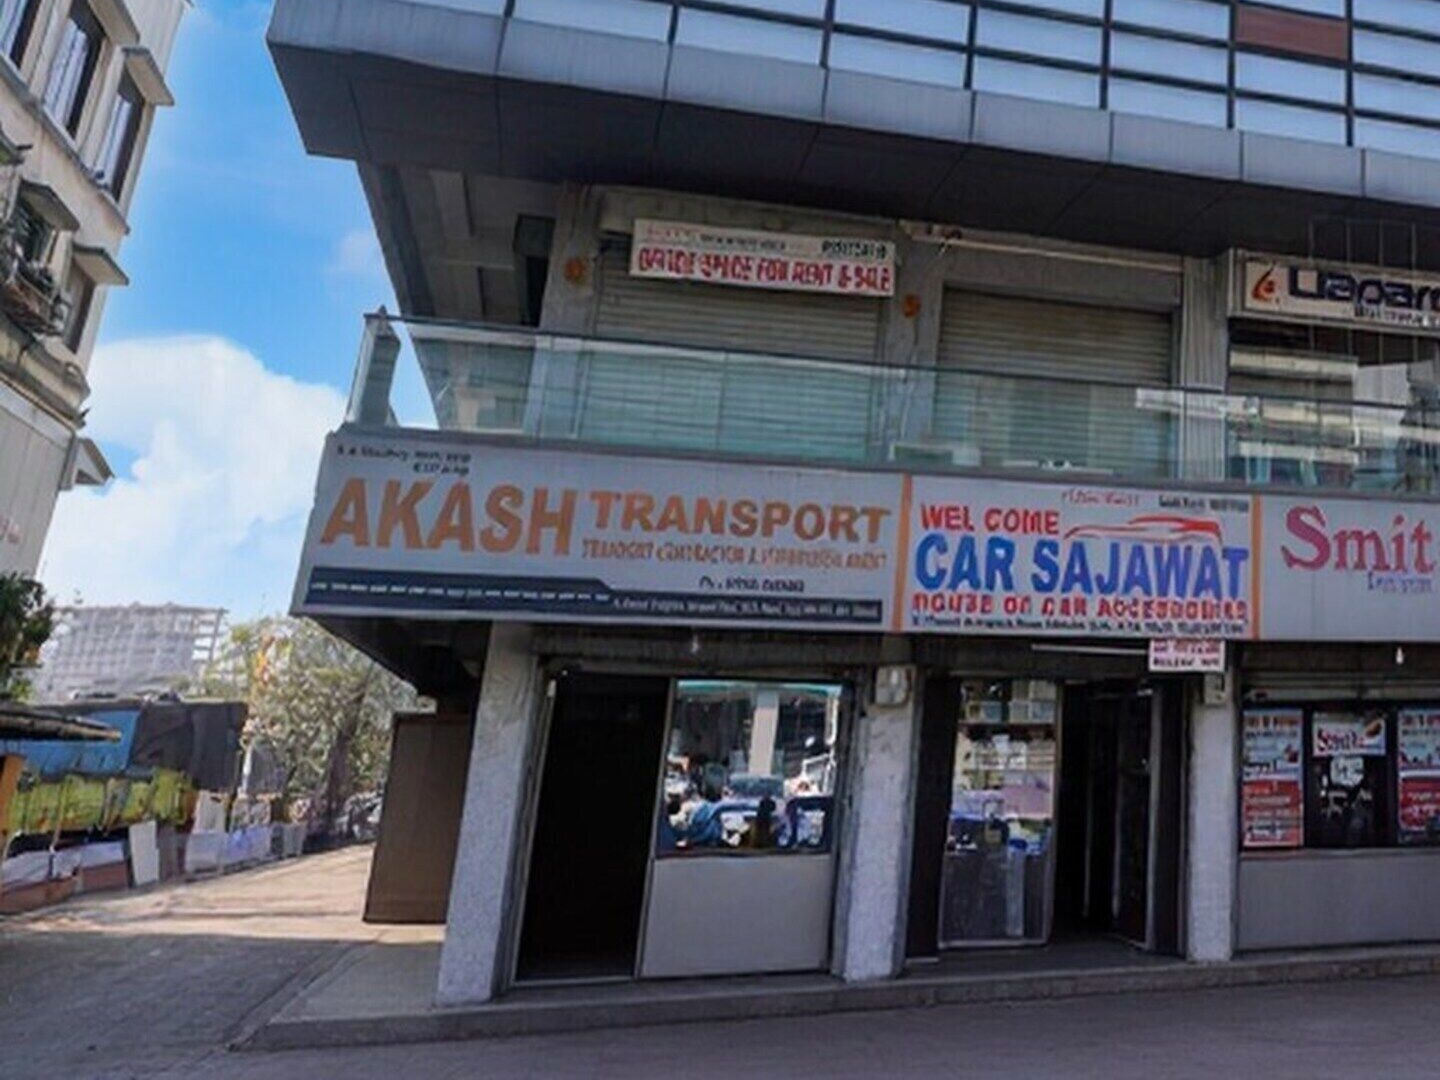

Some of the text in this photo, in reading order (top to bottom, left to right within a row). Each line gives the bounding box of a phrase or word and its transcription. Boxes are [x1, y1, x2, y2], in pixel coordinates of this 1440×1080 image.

[320, 477, 576, 555] AKASH
[589, 491, 891, 542] TRANSPORT
[920, 504, 1060, 535] WEL COME
[1280, 504, 1436, 575] Smit
[915, 533, 1249, 599] CAR SAJAWAT
[912, 593, 993, 614] HOUSE
[1041, 597, 1088, 617] CAR
